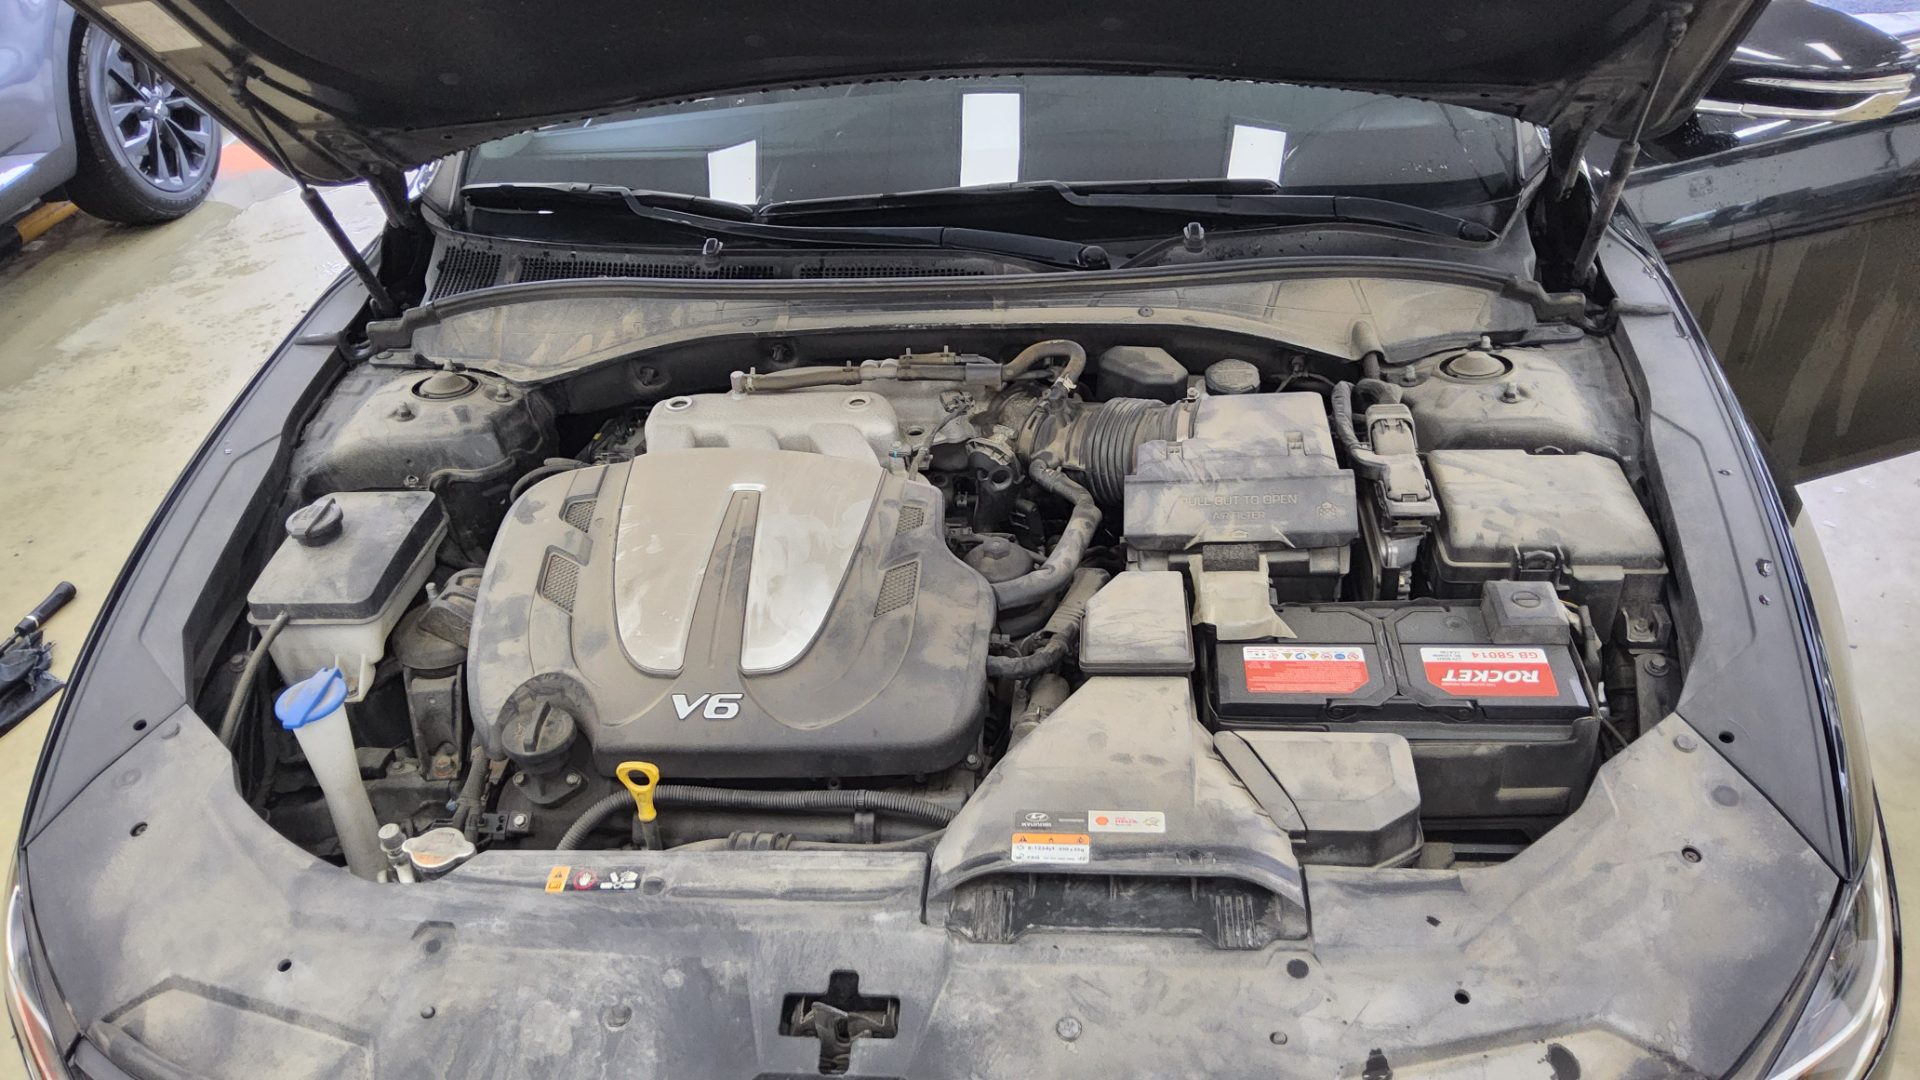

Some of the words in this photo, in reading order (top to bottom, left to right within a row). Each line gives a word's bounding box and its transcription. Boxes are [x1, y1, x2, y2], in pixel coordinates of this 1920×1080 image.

[1243, 494, 1260, 505] TO
[1263, 493, 1298, 505] OPEN
[1471, 651, 1515, 659] 58014
[1520, 651, 1538, 659] GB
[1441, 668, 1540, 683] ROCKET
[671, 692, 745, 720] V6
